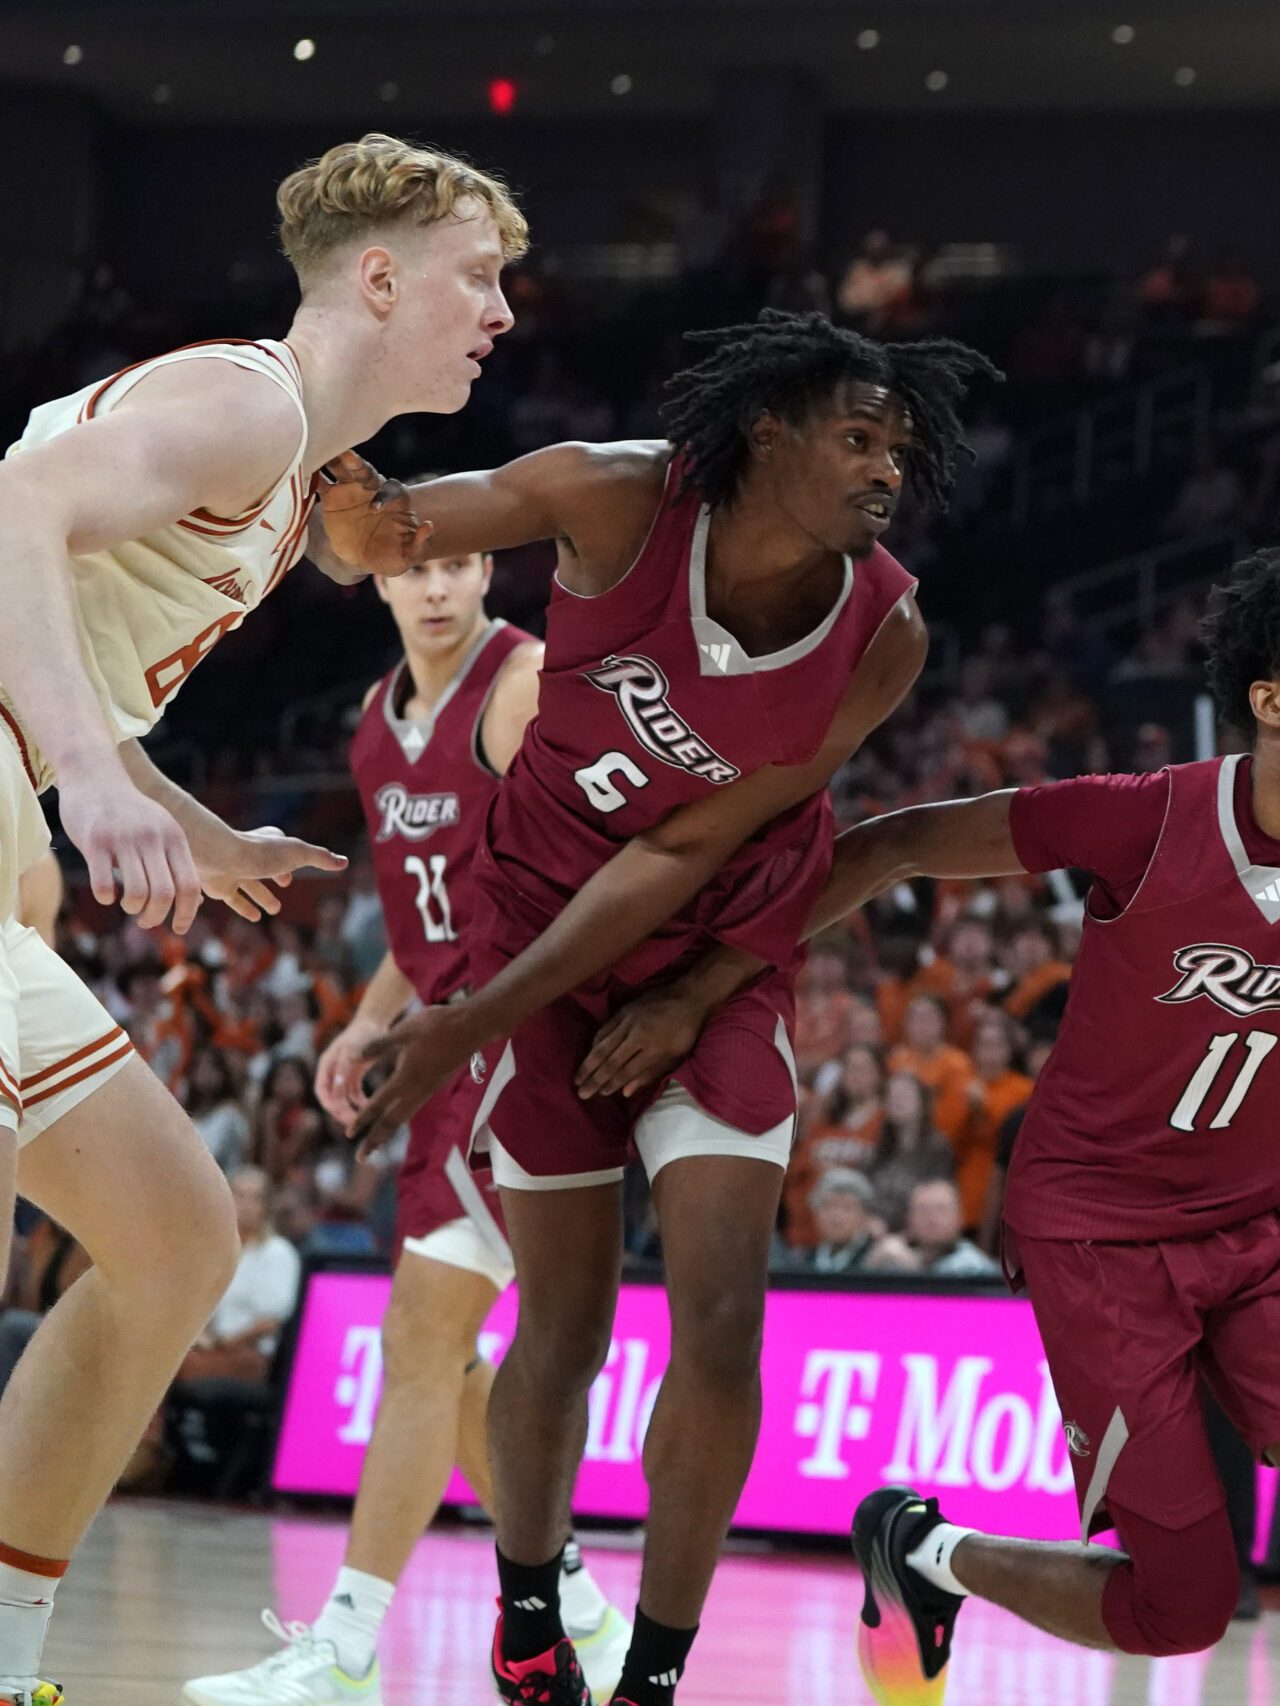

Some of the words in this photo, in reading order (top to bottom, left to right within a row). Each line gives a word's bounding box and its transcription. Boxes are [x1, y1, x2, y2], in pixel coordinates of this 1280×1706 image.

[576, 654, 741, 785] RIDER
[374, 781, 460, 843] RIDER
[574, 751, 649, 813] 6
[404, 855, 458, 942] 21
[1169, 1030, 1279, 1132] 11
[794, 1349, 882, 1480] T
